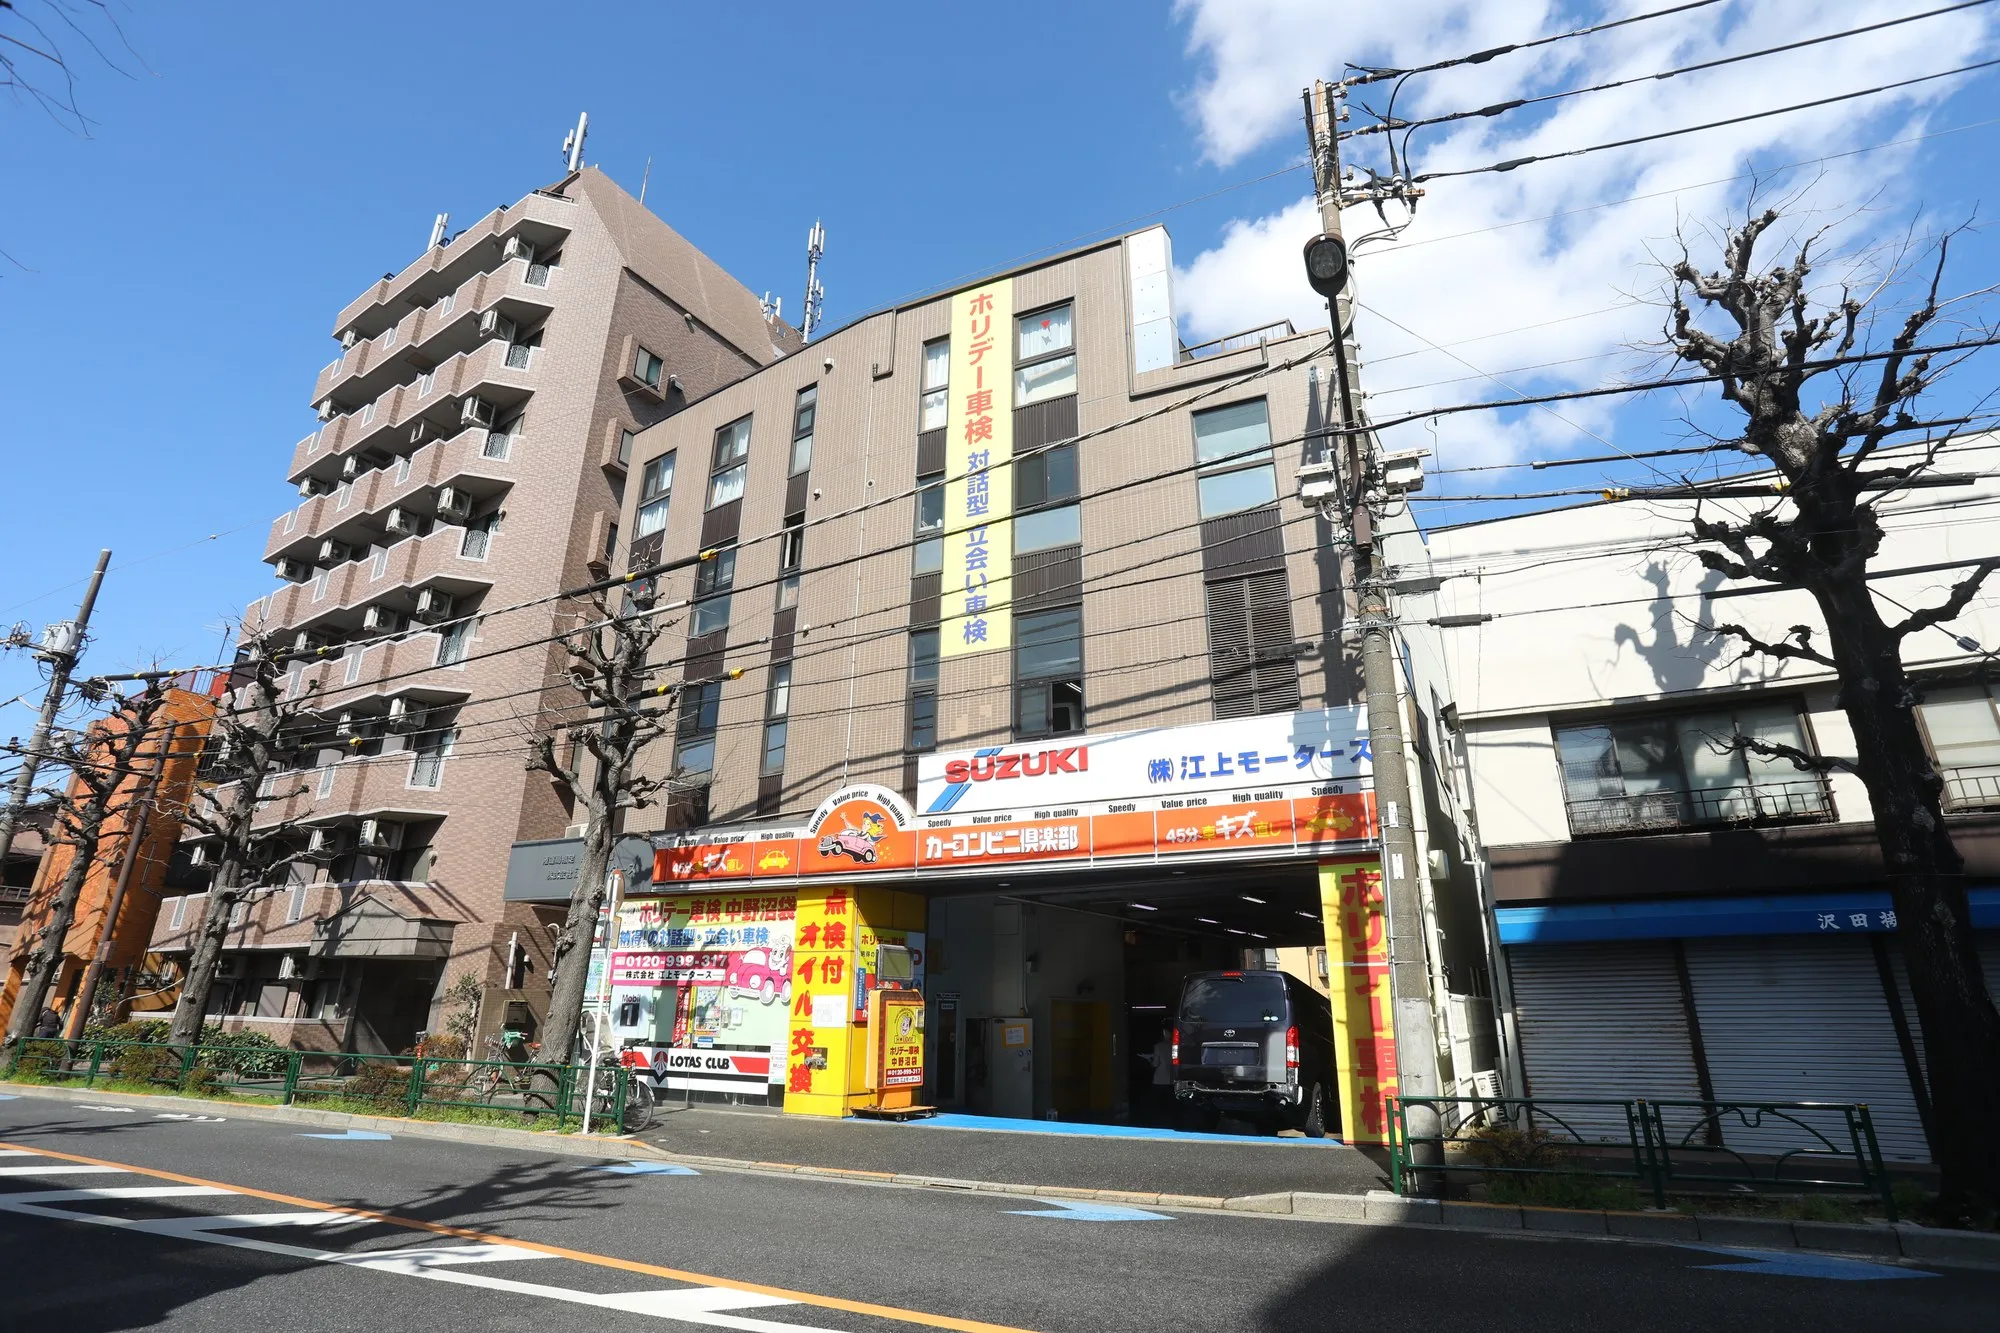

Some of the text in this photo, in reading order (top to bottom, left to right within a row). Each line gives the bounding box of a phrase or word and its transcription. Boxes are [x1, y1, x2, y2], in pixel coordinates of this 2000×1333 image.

[963, 293, 994, 645] ホリデー車検 対話型 立会い車検
[945, 745, 1088, 784] SUZUKI
[1161, 790, 1283, 809] Value price High quality
[1311, 785, 1343, 796] Speedy
[810, 790, 906, 834] Speedy Value price High quality
[1108, 803, 1136, 814] Speedy
[928, 808, 1079, 829] Speedy Value price High quality
[730, 835, 745, 843] price
[760, 832, 774, 840] High
[775, 831, 794, 839] quality
[926, 825, 1079, 860] カーコンビニ倶楽部
[639, 896, 797, 923] ホリデー車検 中野沼袋
[822, 888, 847, 984] 点検付
[625, 954, 728, 967] 0120-999-317
[625, 970, 712, 979] 株式会社 江上モータース
[622, 994, 641, 1002] Mobil
[670, 1055, 730, 1069] LOTAS CLUB
